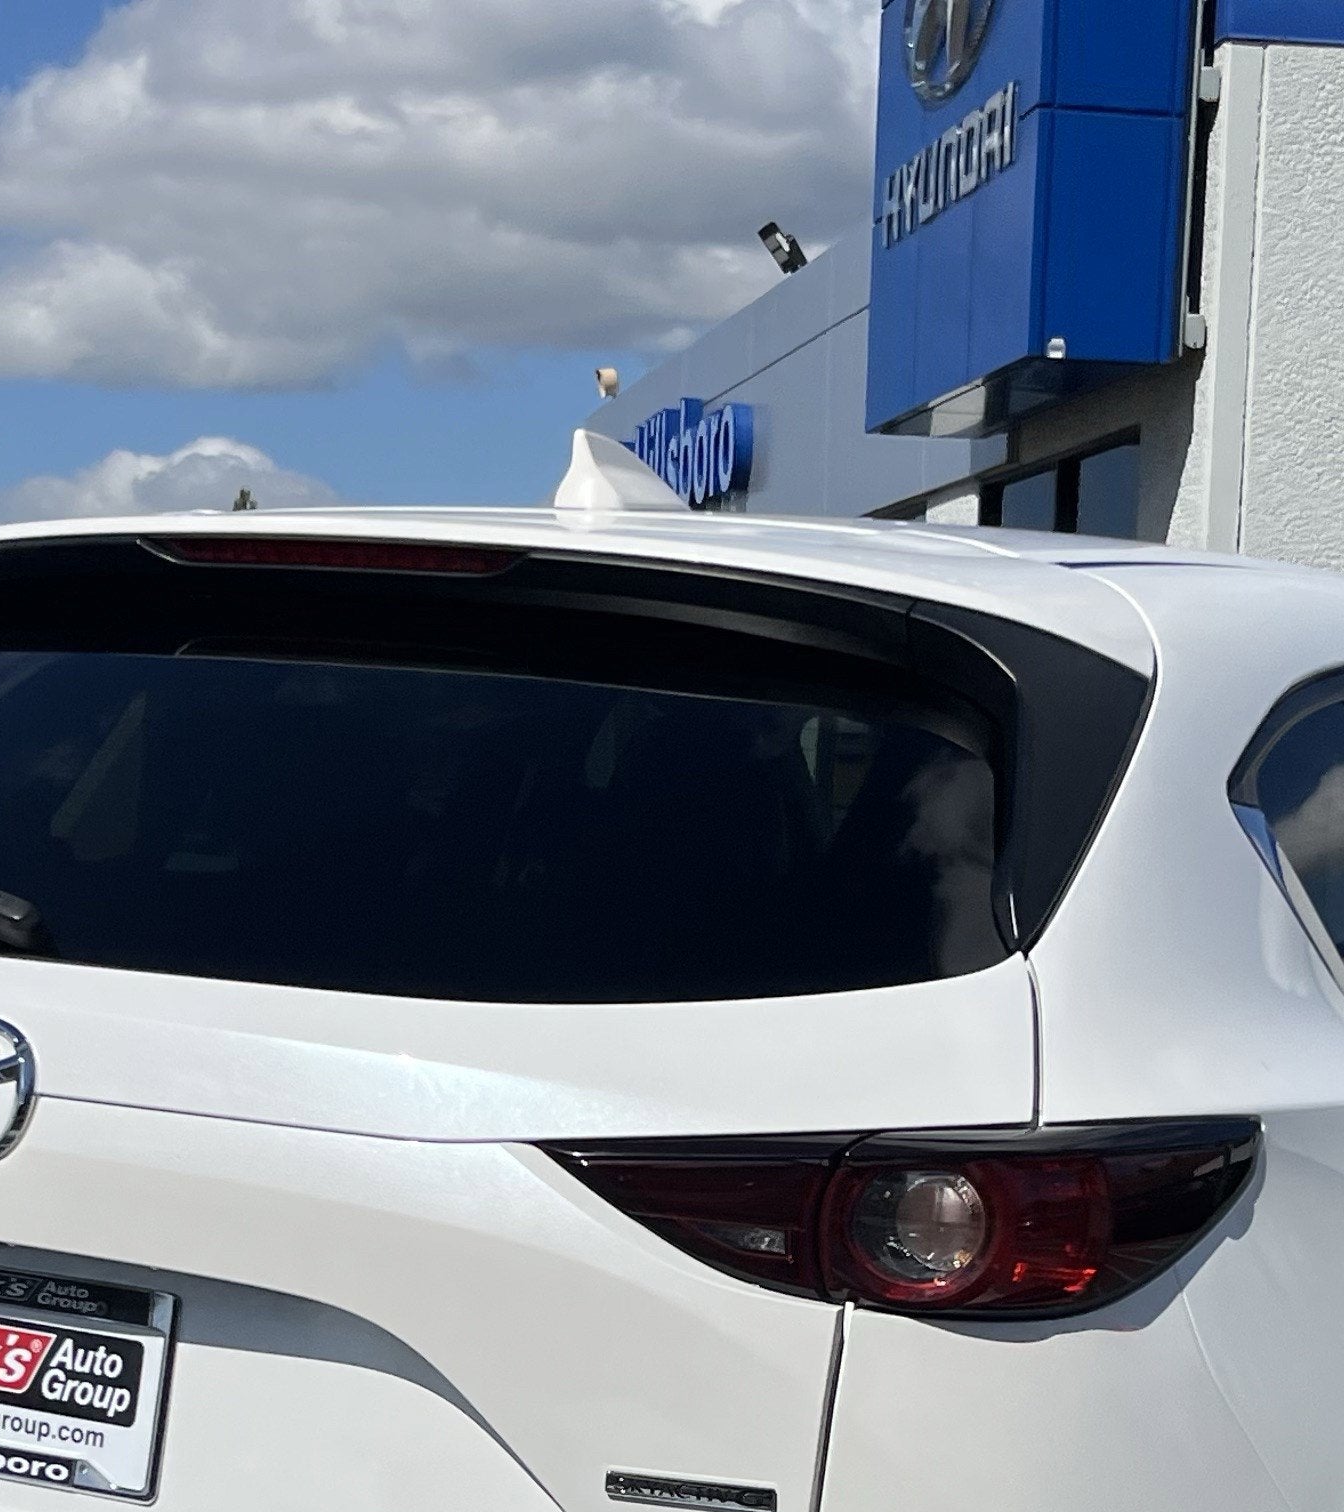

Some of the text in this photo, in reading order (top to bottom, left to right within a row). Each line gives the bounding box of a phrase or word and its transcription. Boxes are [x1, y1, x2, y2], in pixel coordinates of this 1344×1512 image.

[882, 81, 1017, 249] HYUNDAI
[37, 1292, 99, 1313] Group
[43, 1280, 90, 1299] Auto
[50, 1337, 124, 1379] Auto
[41, 1368, 131, 1417] Group
